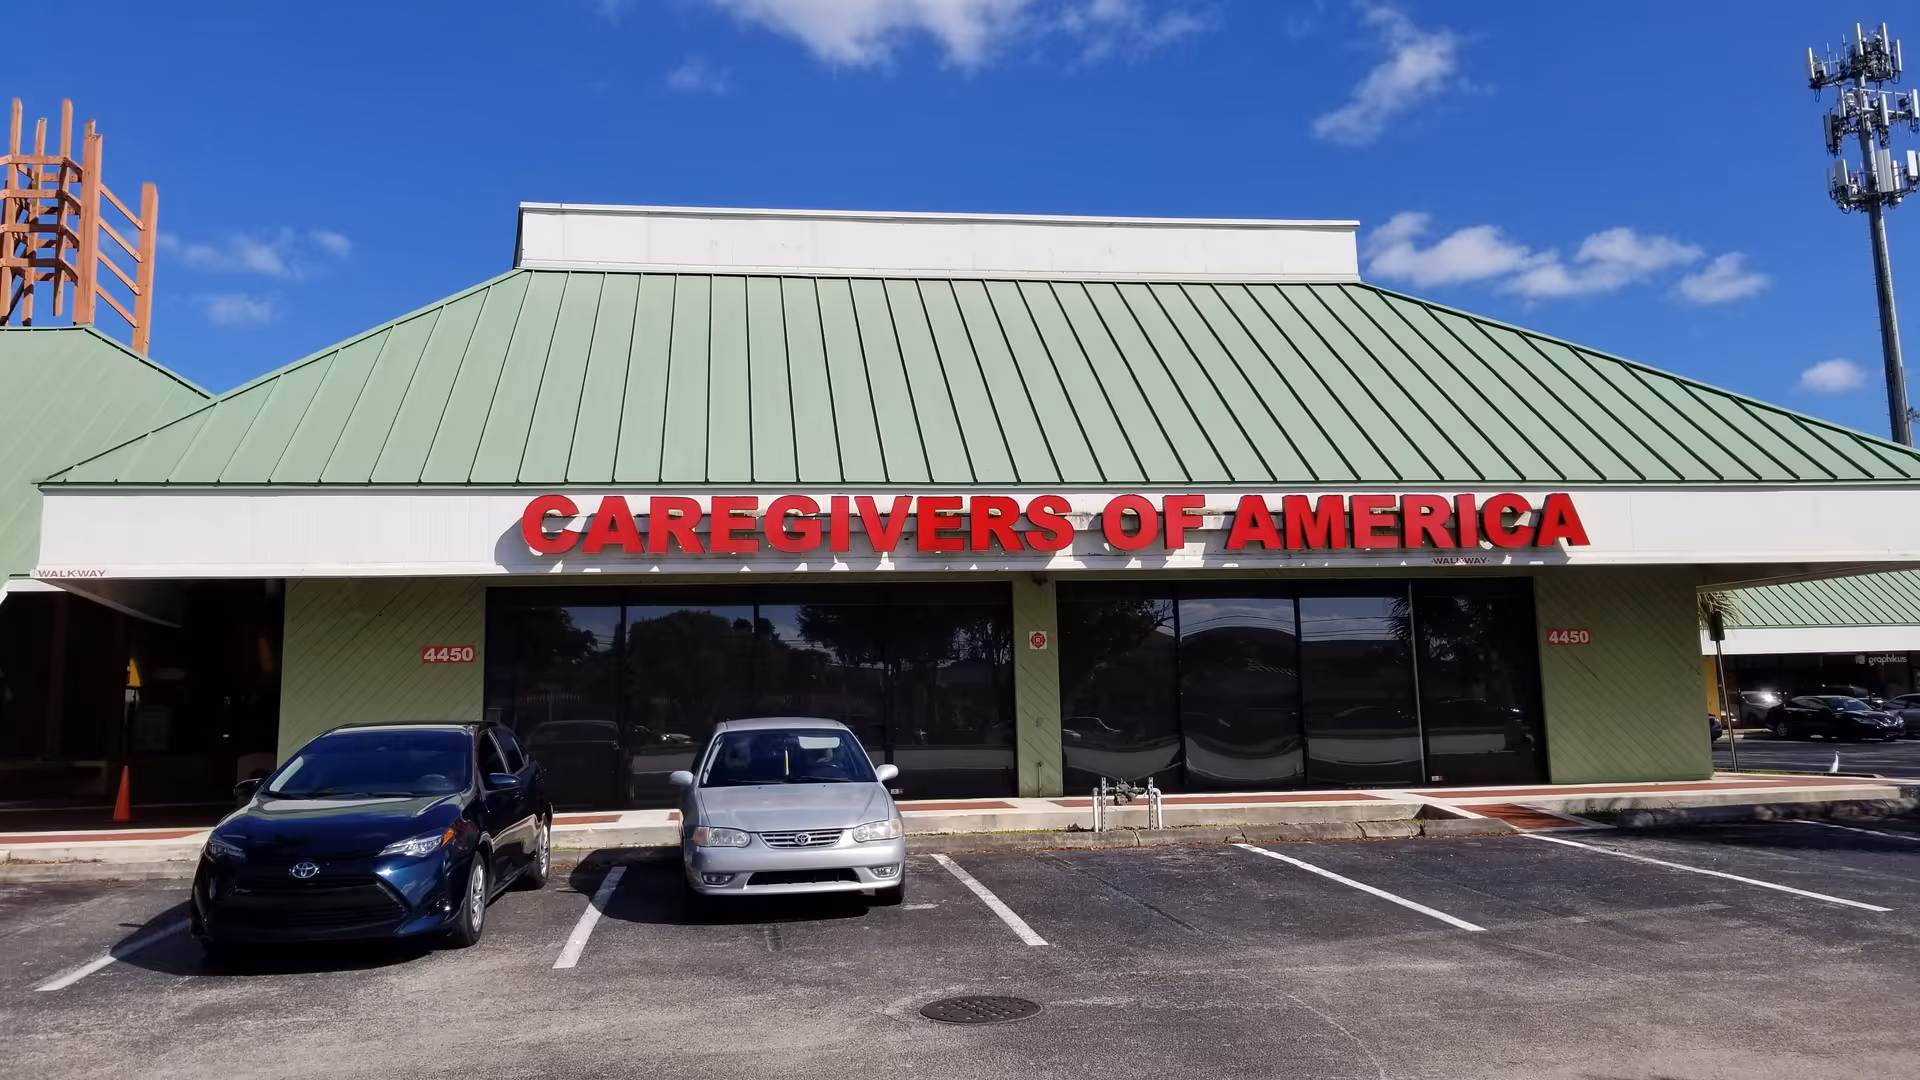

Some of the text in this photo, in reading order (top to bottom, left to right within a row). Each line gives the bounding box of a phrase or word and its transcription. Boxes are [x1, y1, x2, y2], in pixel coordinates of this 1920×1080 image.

[521, 493, 1590, 554] CAREGIVERS OF AMERICA
[1549, 630, 1589, 643] 4450
[423, 647, 474, 661] 4450
[1868, 653, 1908, 666] graphikus
